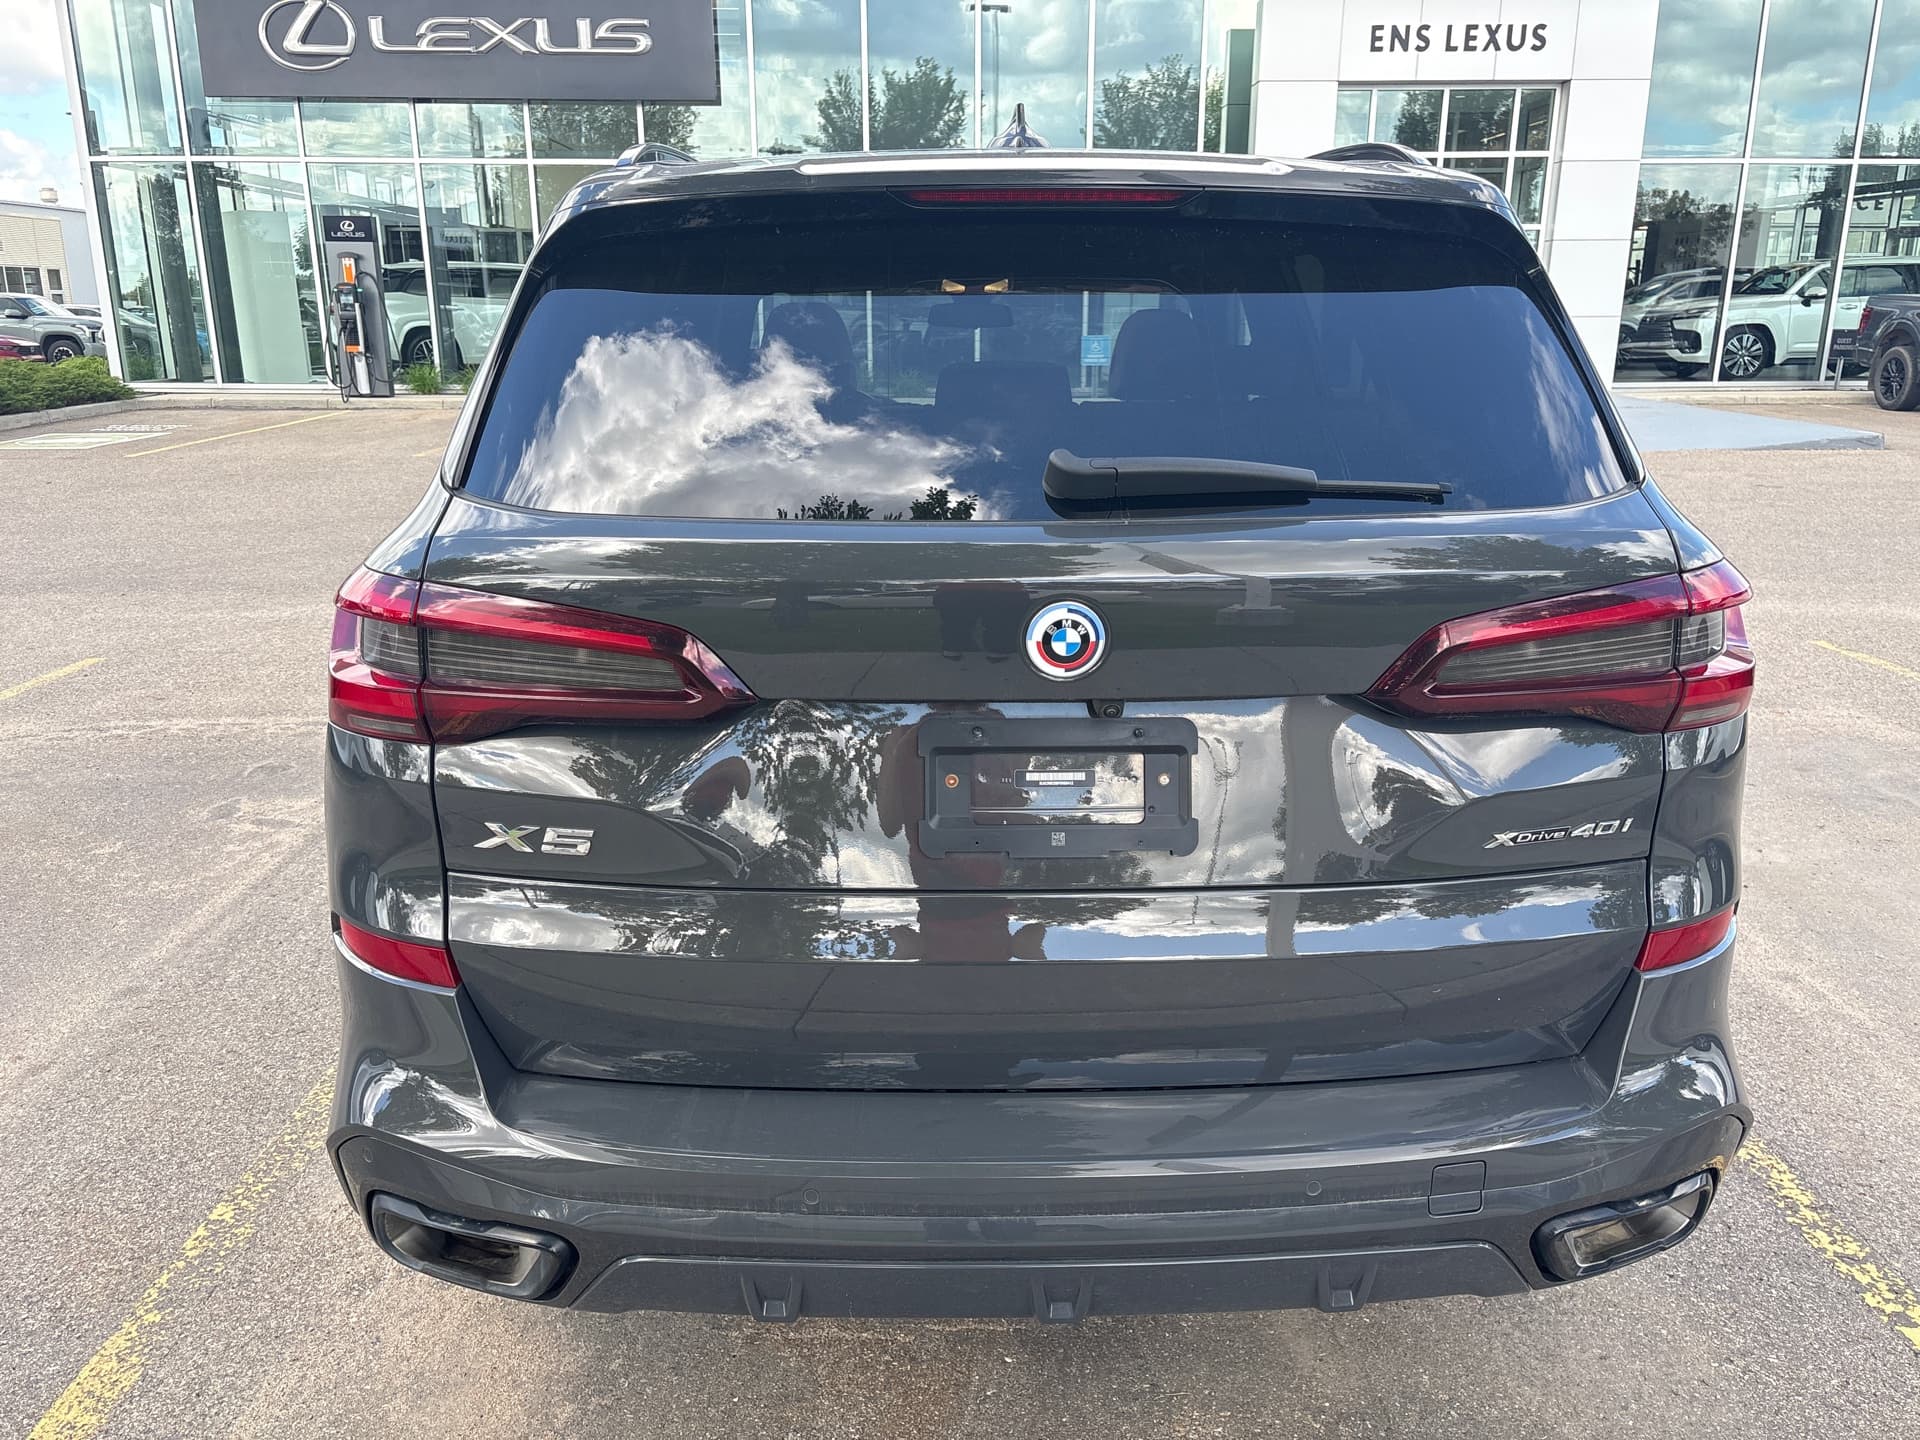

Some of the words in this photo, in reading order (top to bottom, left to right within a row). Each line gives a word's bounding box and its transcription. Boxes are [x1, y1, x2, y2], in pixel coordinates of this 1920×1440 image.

[367, 16, 653, 55] LEXUS
[1369, 24, 1431, 53] ENS
[1445, 23, 1548, 52] LEXUS
[1047, 619, 1087, 635] BMW
[473, 822, 594, 856] X5
